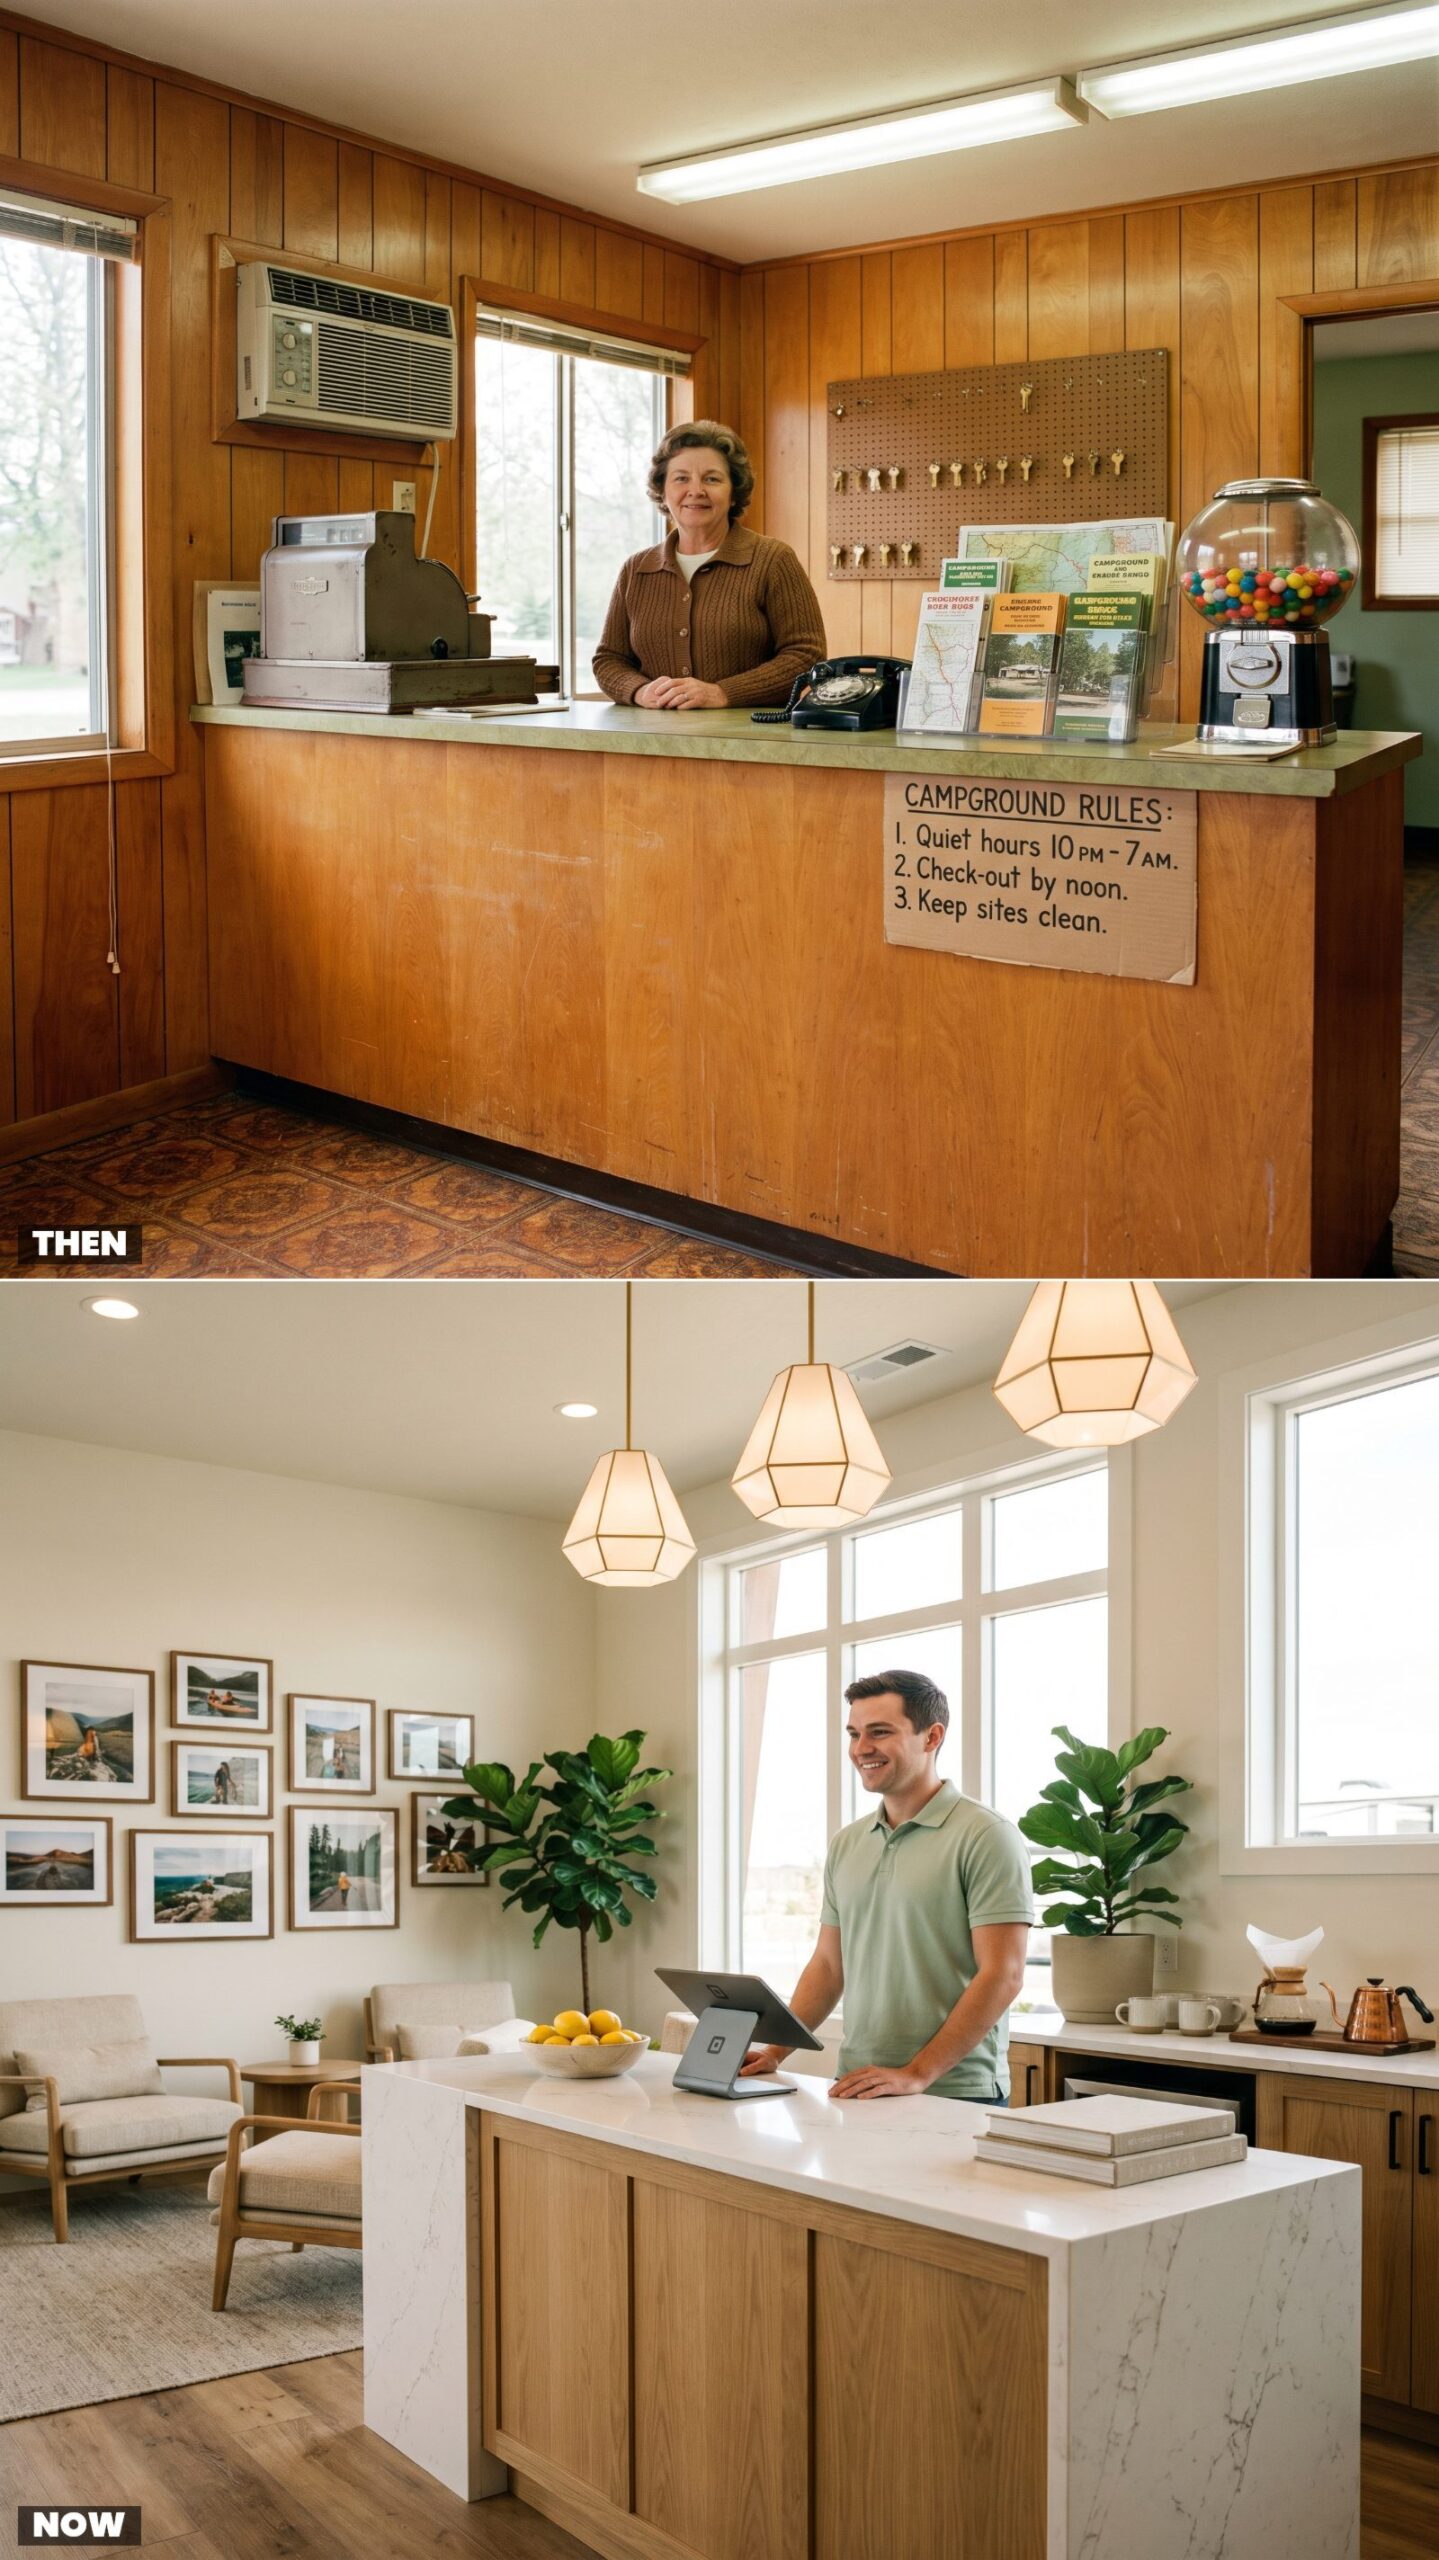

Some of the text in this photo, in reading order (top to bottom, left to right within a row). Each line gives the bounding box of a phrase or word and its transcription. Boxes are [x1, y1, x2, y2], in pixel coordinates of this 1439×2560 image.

[1094, 559, 1149, 567] CAMPGROUND
[905, 783, 1173, 825] CAMPGROUND RULES:
[895, 822, 906, 845] 1.
[916, 823, 972, 850] Quiet
[981, 829, 1040, 857] hours
[894, 853, 1128, 901] 2. Check-out by noon.
[894, 886, 1107, 934] 3. Keep sites clean.
